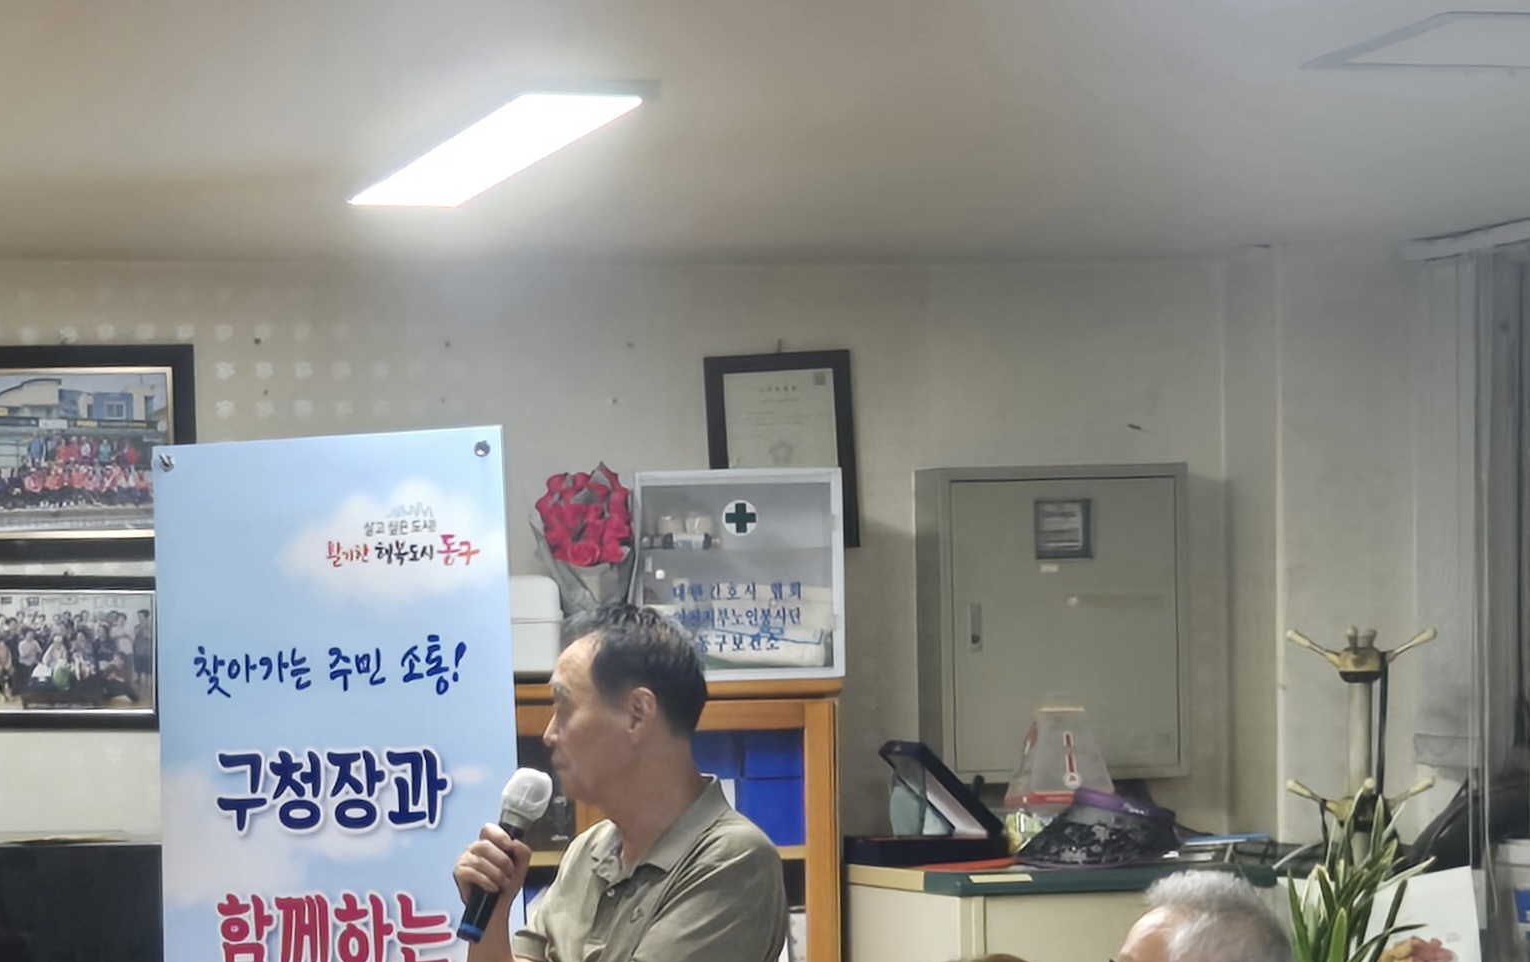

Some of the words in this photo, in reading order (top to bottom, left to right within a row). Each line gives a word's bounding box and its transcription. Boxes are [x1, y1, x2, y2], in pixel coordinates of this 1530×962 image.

[326, 541, 370, 567] 활기찬
[375, 540, 435, 566] 행복도시
[437, 534, 481, 566] 동구
[193, 645, 312, 698] 찾아가는
[328, 647, 386, 692] 주민
[400, 634, 467, 696] 소통!
[217, 749, 448, 832] 구청장과
